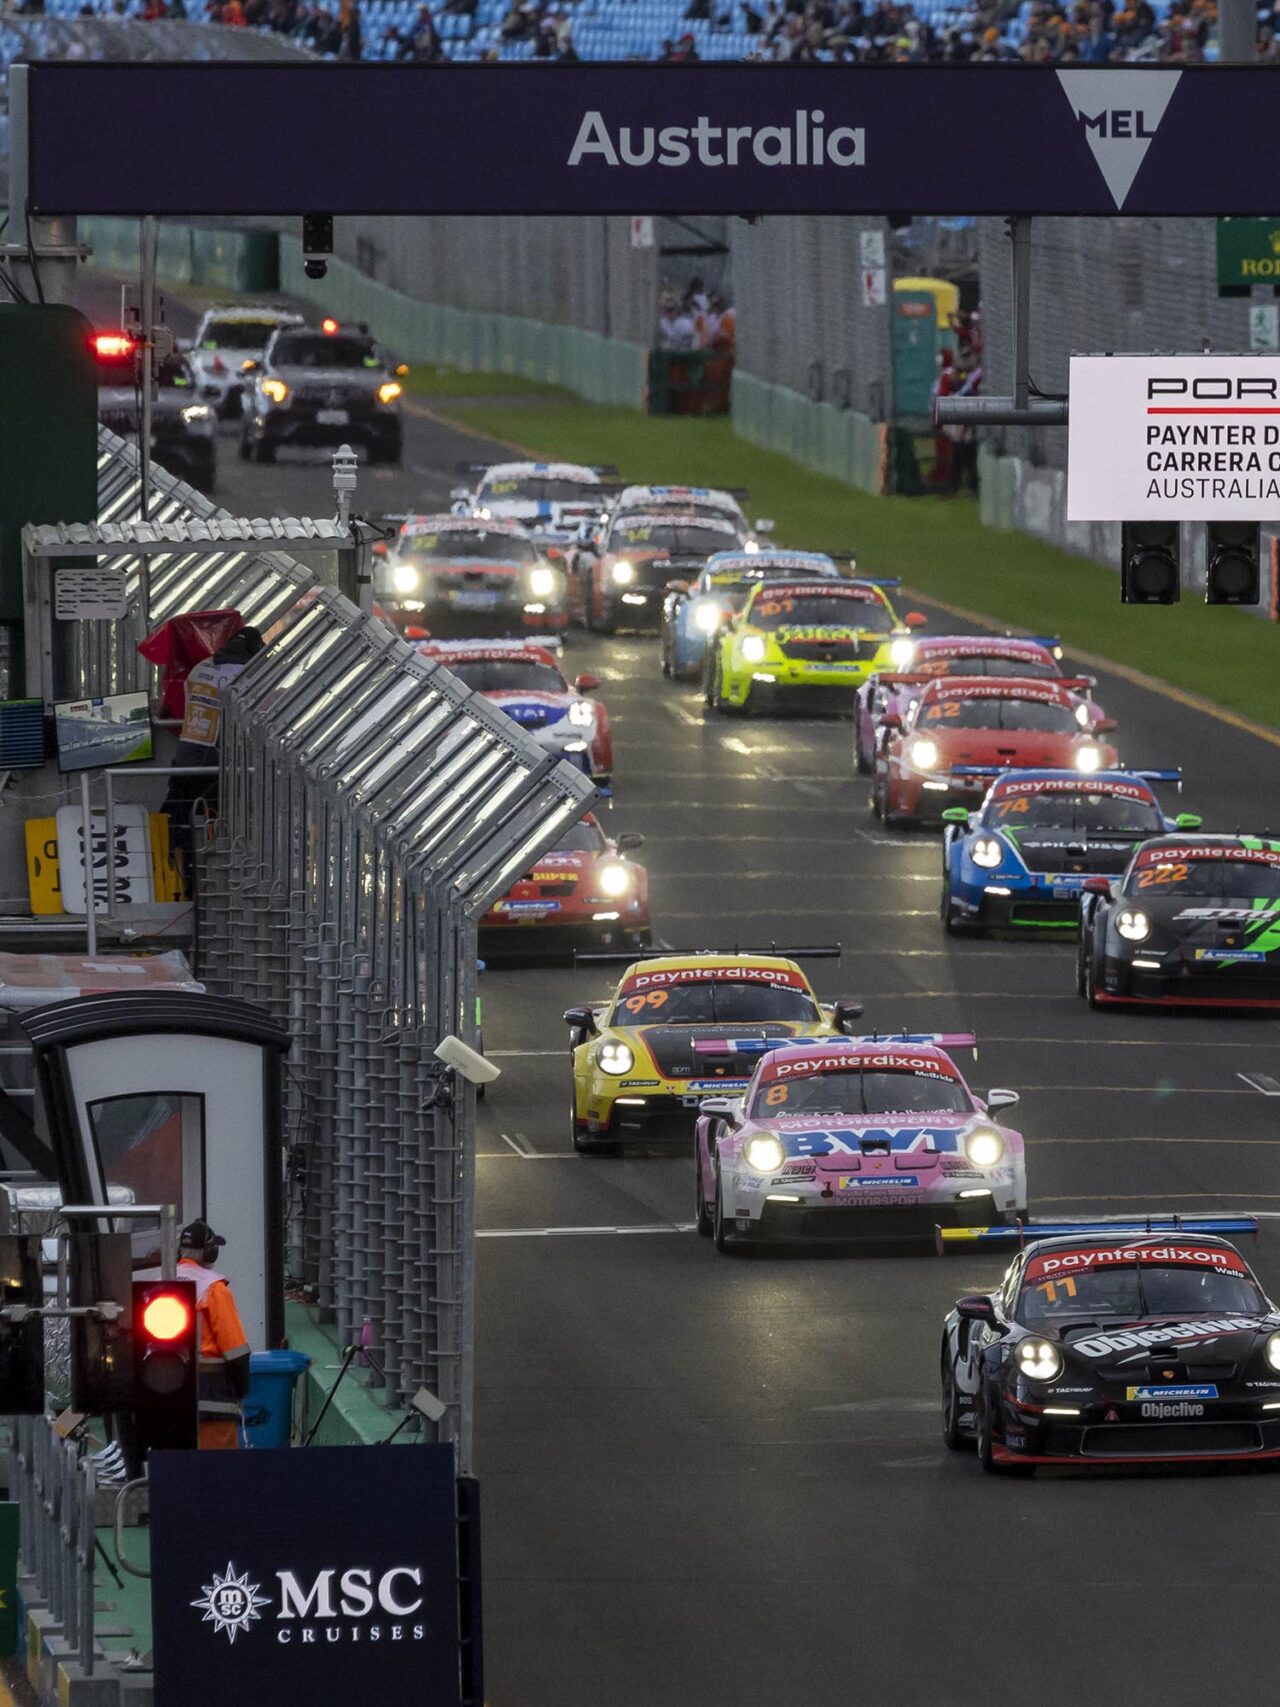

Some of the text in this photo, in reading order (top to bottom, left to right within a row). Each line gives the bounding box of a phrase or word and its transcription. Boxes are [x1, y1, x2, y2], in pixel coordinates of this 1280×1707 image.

[1078, 109, 1156, 139] MEL
[566, 109, 866, 167] Australia
[1146, 425, 1256, 446] PAYNTER
[1146, 451, 1262, 472] CARRERA
[1146, 478, 1280, 499] AUSTRALIA
[1005, 780, 1140, 797] paynterdixon
[994, 796, 1030, 818] 74
[1137, 863, 1190, 889] 222
[635, 968, 791, 988] paynterdixon
[625, 990, 669, 1015] 99
[776, 1055, 941, 1077] paynterdixon
[914, 1070, 955, 1083] McBride
[765, 1084, 788, 1107] 8
[777, 1128, 968, 1158] BWT
[1042, 1248, 1228, 1273] paynterdixon
[1214, 1266, 1245, 1279] Walls
[1036, 1276, 1078, 1302] 11
[1072, 1319, 1263, 1358] Objective
[1152, 1388, 1210, 1396] MICHELIN
[1141, 1402, 1204, 1419] Objective
[275, 1567, 423, 1619] MSC
[277, 1625, 424, 1644] CRUISES
